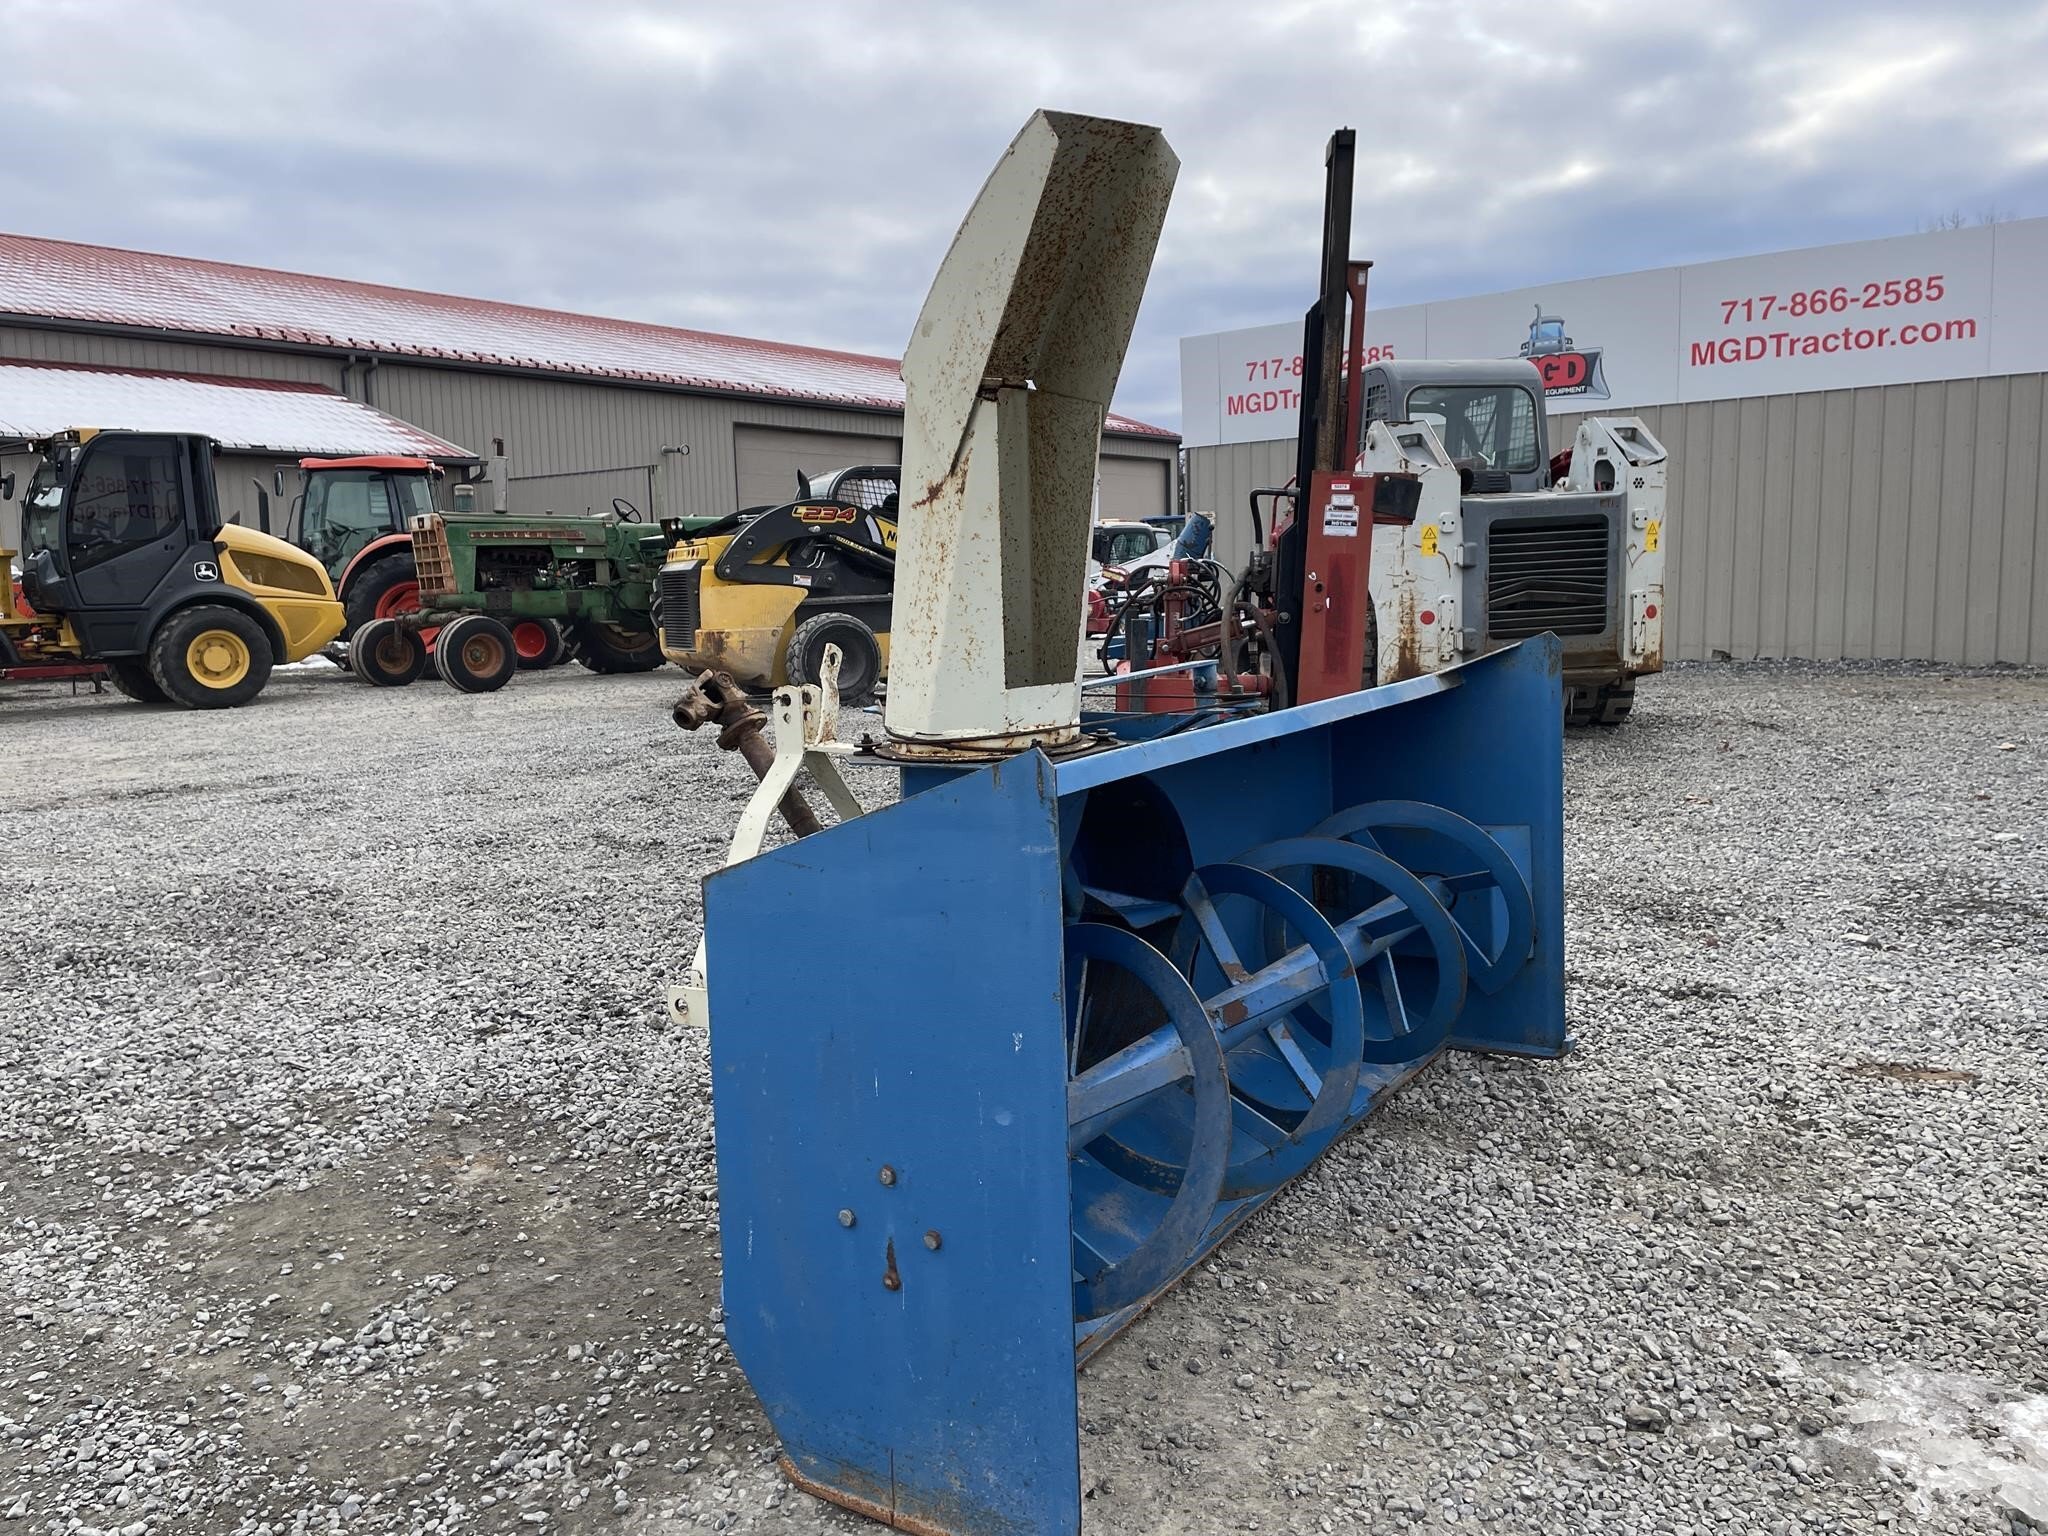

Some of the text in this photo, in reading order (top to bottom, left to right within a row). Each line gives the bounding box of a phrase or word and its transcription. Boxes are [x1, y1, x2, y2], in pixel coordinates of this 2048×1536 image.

[1721, 275, 1944, 325] 717-866-2585
[1690, 318, 1977, 367] MGDTractor.com
[1227, 389, 1300, 416] MGDTr
[1545, 385, 1586, 396] EQUIPMENT
[792, 505, 857, 523] L234
